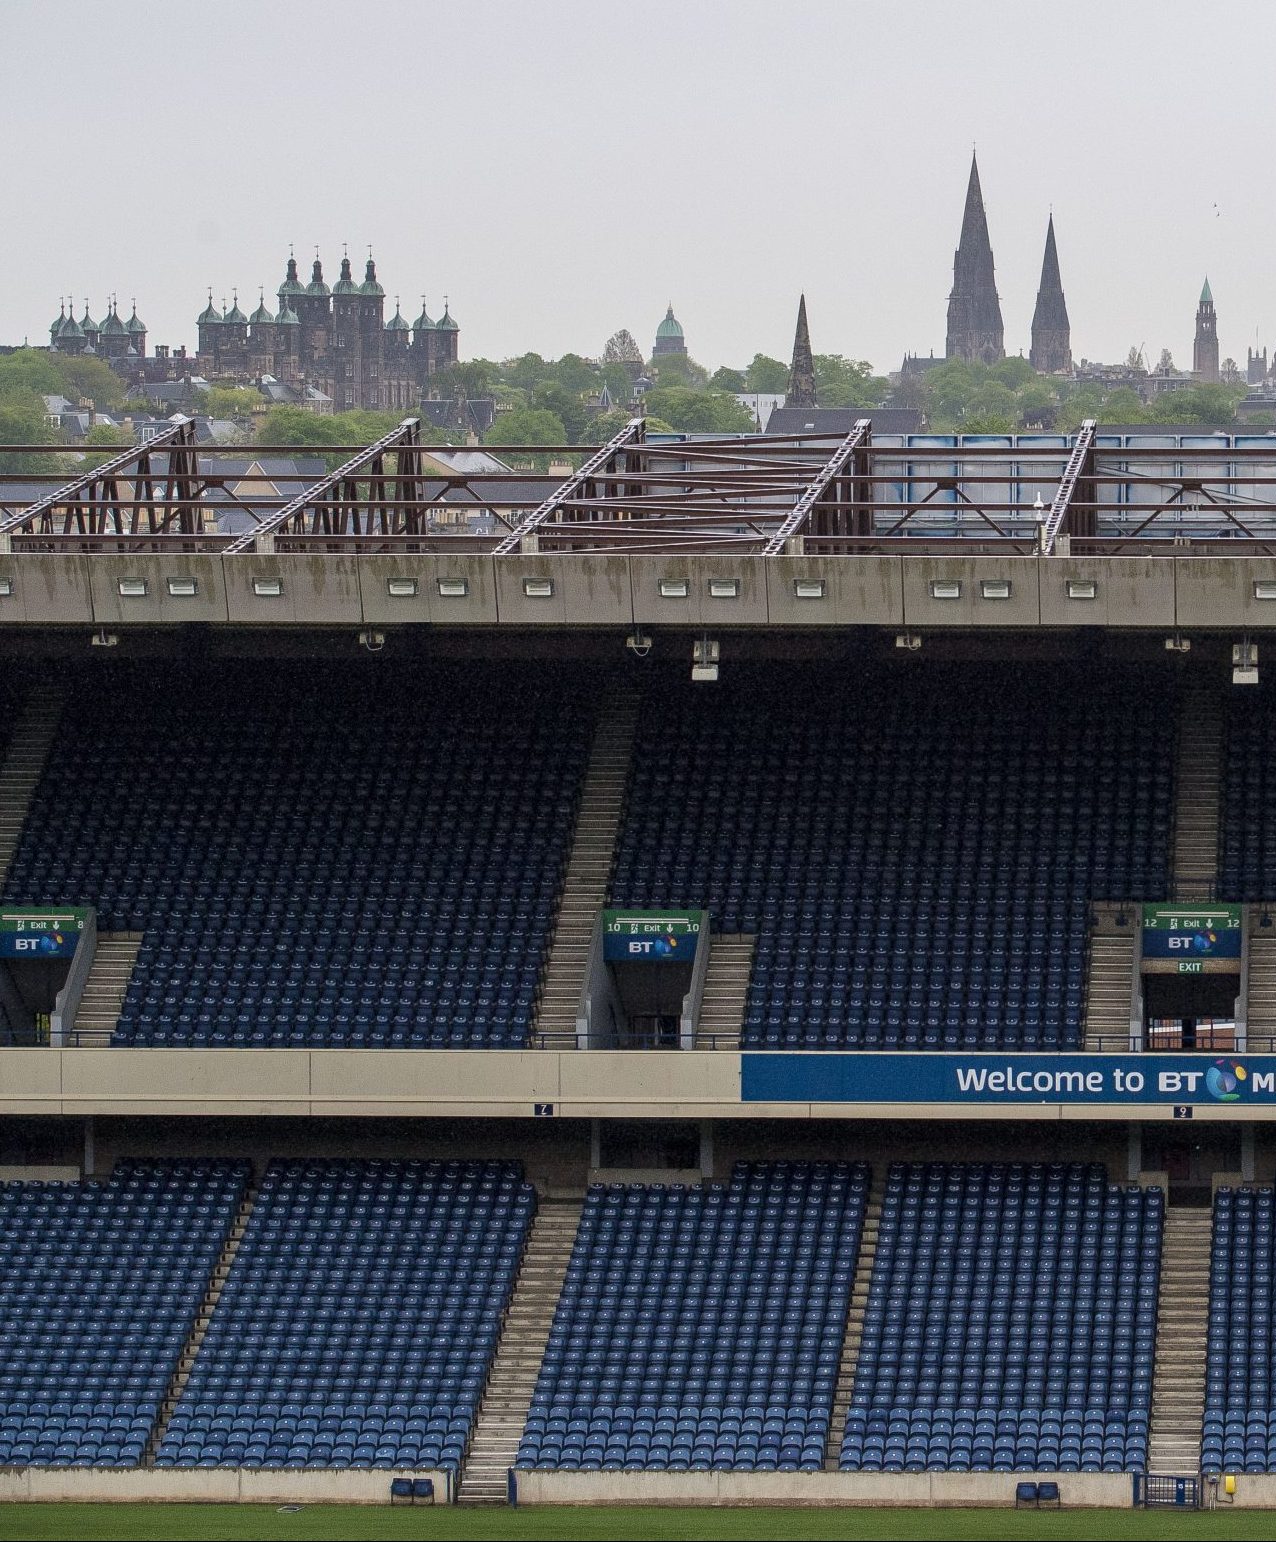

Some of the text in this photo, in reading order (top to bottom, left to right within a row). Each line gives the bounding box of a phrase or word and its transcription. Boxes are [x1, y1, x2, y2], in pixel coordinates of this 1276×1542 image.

[30, 920, 84, 929] Exit 8
[607, 924, 700, 932] 10 Exit 10
[1144, 919, 1240, 928] 12 Exit 12
[15, 938, 40, 950] BT
[628, 942, 654, 953] BT
[1168, 937, 1193, 949] BT
[1179, 962, 1202, 972] EXIT
[956, 1067, 1103, 1092] Welcome
[1113, 1068, 1144, 1092] to
[1158, 1072, 1204, 1092] BT
